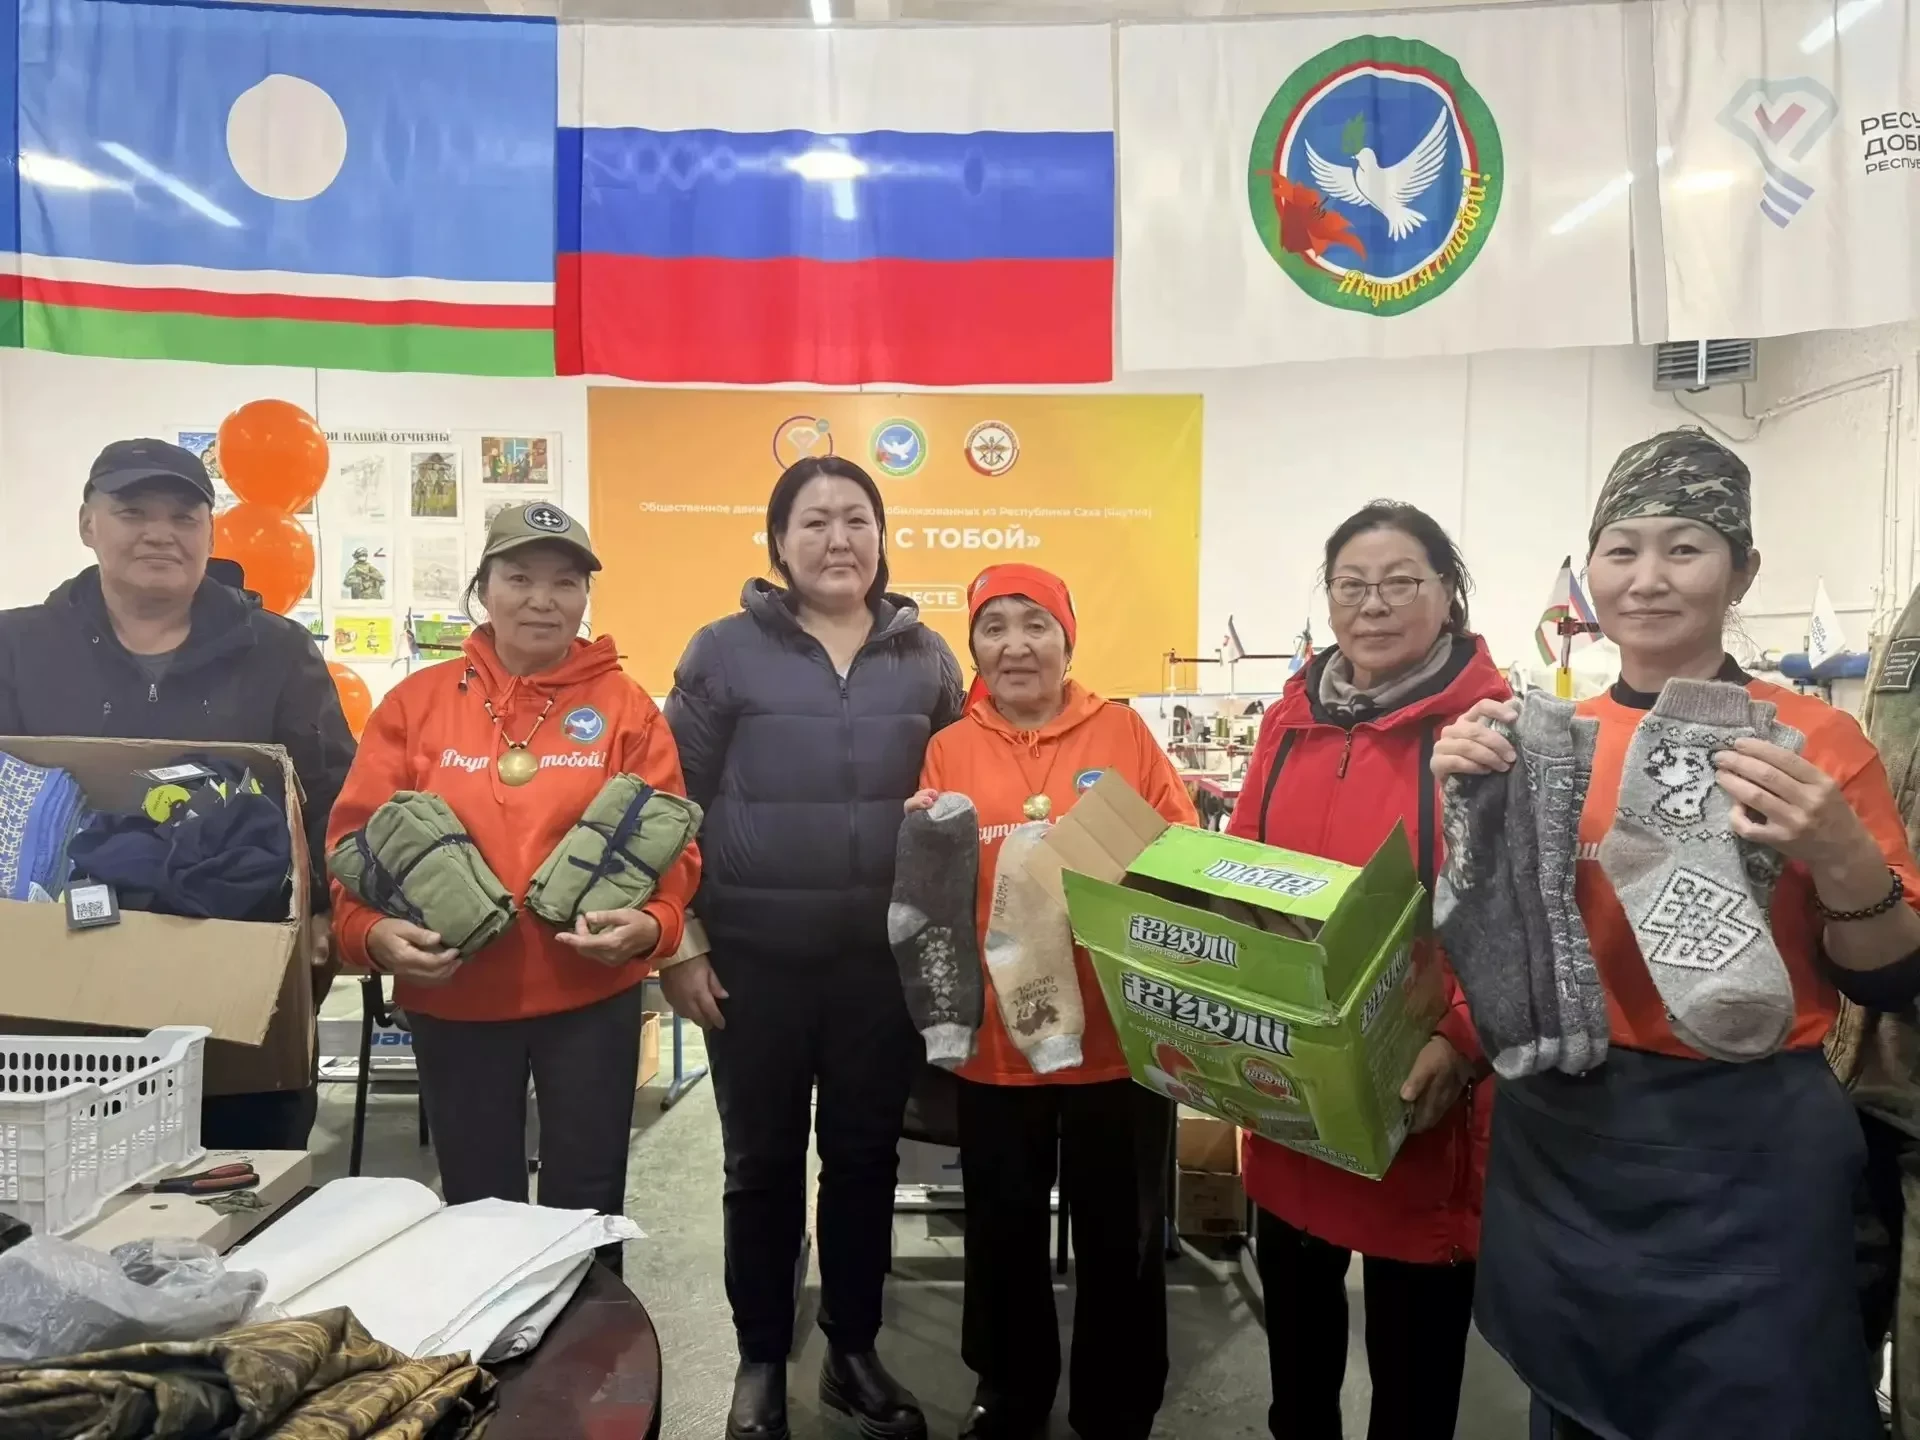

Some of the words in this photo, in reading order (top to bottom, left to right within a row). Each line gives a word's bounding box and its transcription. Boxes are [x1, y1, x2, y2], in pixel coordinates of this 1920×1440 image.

[1864, 134, 1920, 161] ДОБ
[1337, 269, 1436, 308] Якутия
[1443, 168, 1491, 265] тобой!
[343, 431, 388, 442] НАШЕЙ
[390, 431, 451, 443] ОТЧИЗНЫ
[639, 501, 731, 514] Общественное
[732, 504, 767, 515] движ
[885, 505, 981, 517] обилизованных
[982, 509, 997, 517] из
[999, 507, 1071, 519] Республики
[1073, 507, 1101, 517] Саха
[895, 527, 915, 549] С
[922, 523, 1041, 550] ТОБОЙ»
[540, 750, 608, 768] тобой!
[1129, 914, 1238, 969] 超级心
[1120, 971, 1295, 1059] 超级心
[1126, 1001, 1209, 1041] SuperHeart
